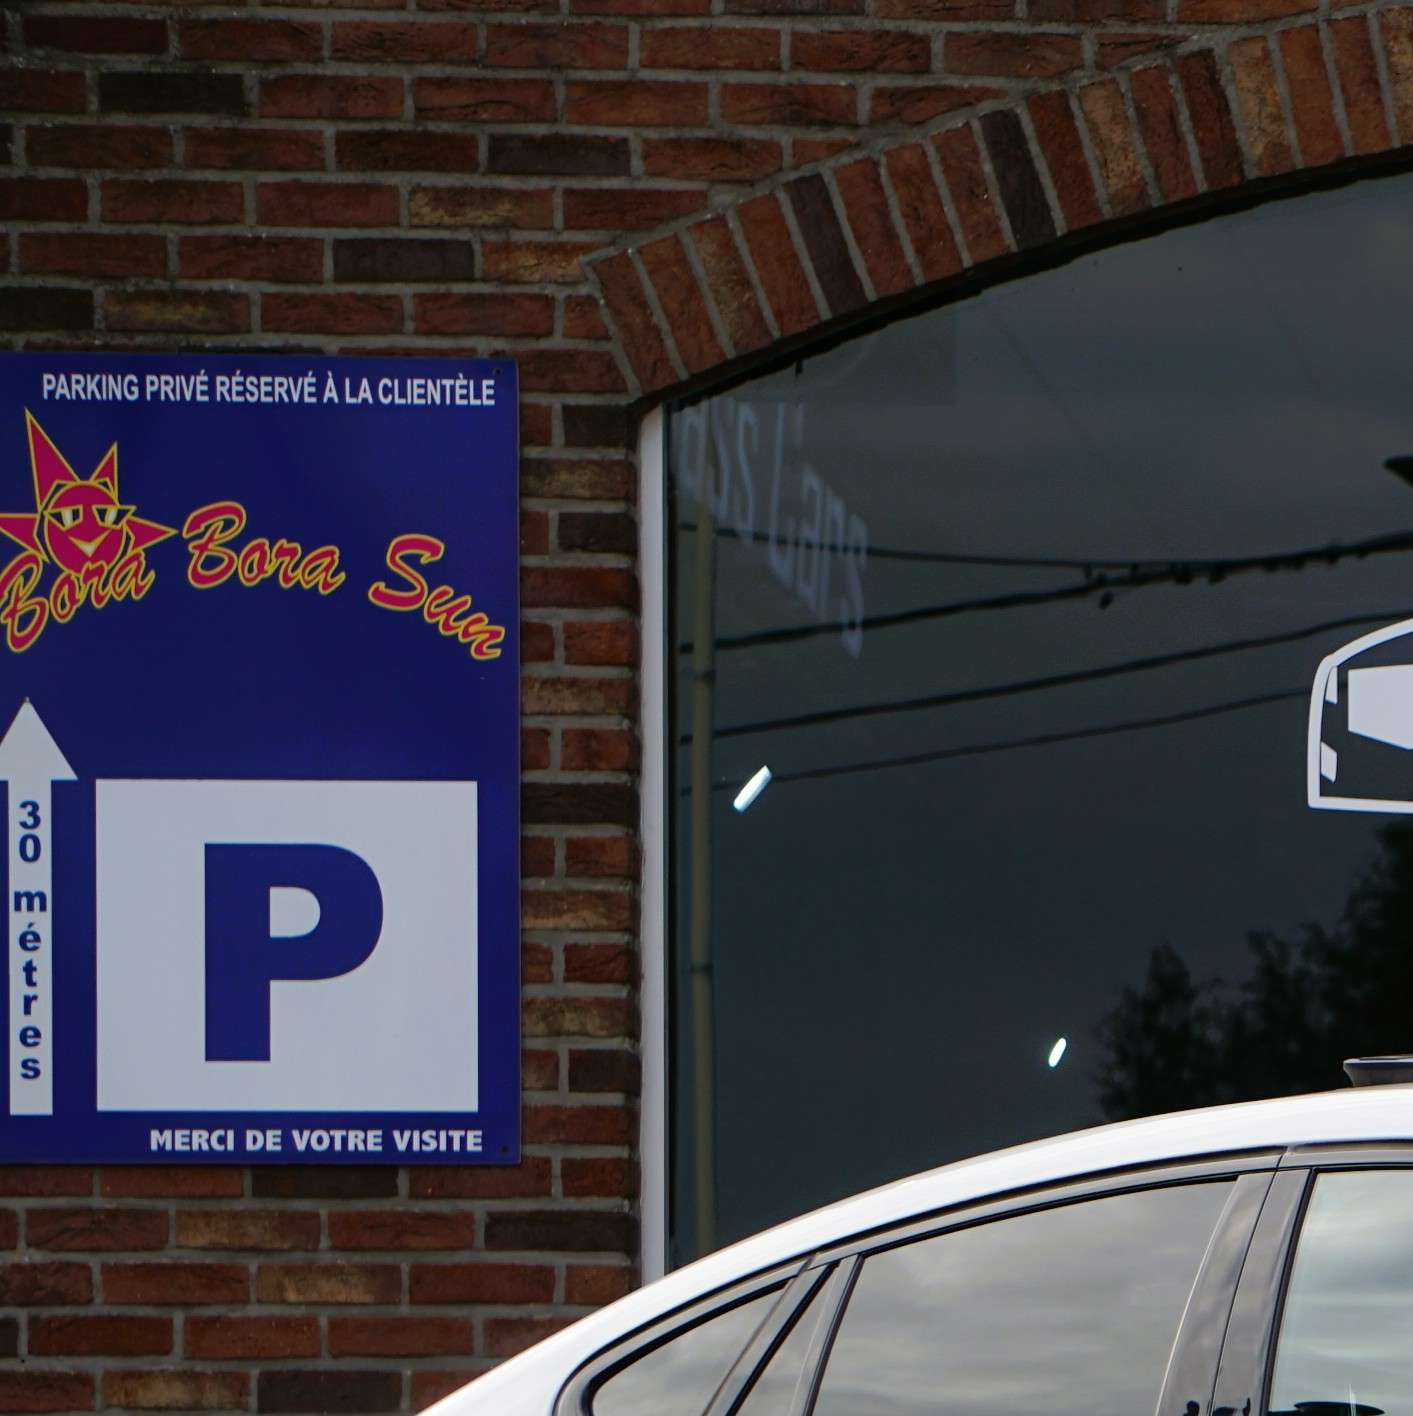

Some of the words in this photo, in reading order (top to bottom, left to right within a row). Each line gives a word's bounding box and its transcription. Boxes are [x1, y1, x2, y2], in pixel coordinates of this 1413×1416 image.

[42, 373, 139, 401] PARKING
[145, 369, 210, 402] PRIVÉ
[215, 369, 317, 403] RÉSERVÉ
[322, 370, 339, 404] À
[344, 377, 374, 405] LA
[378, 373, 496, 406] CLIENTÈLE
[0, 549, 156, 654] Bora
[182, 501, 346, 595] Bora
[368, 533, 506, 660] Sun
[18, 800, 42, 863] 30
[204, 843, 384, 1062] P
[150, 1129, 235, 1151] MERCI
[245, 1129, 282, 1152] DE
[291, 1129, 383, 1152] VOTRE
[392, 1129, 483, 1152] VISITE
